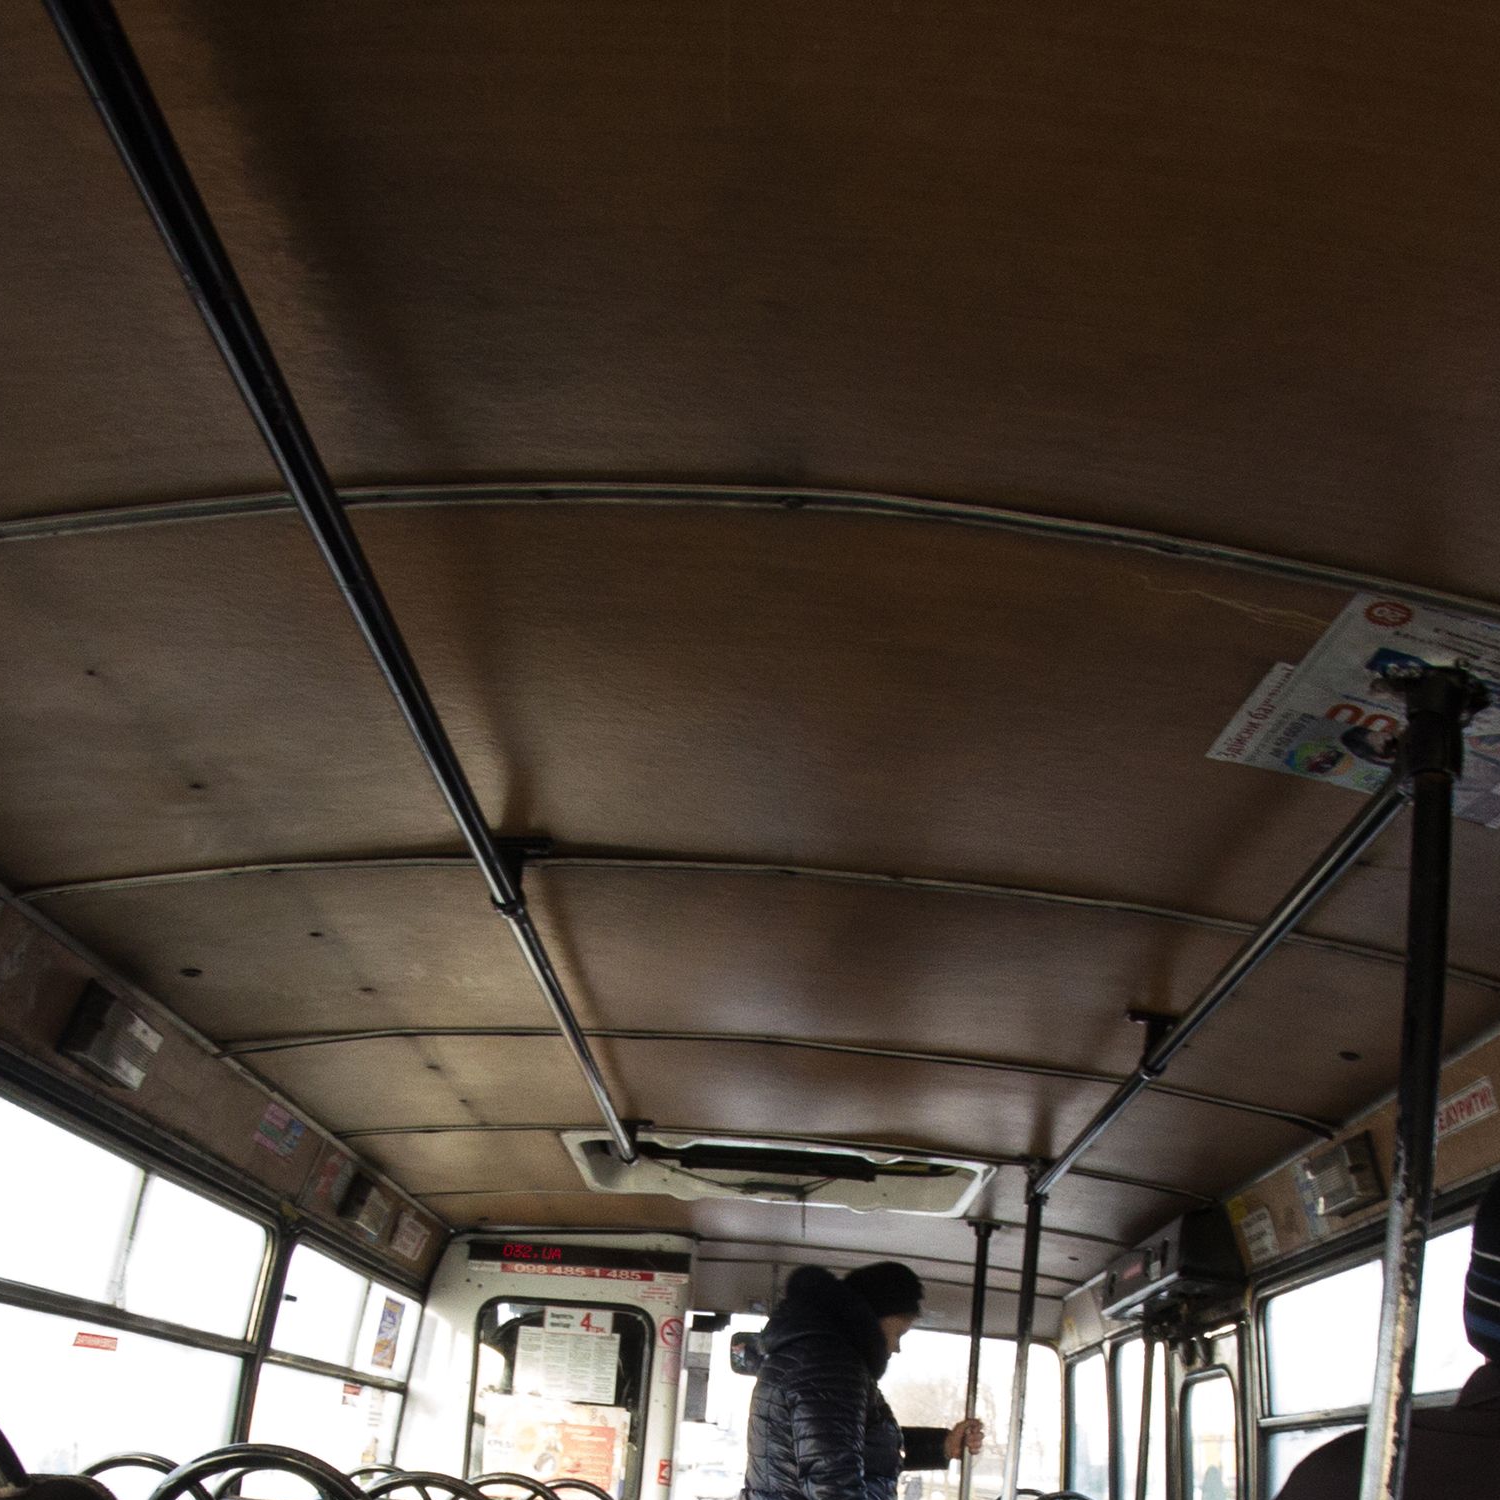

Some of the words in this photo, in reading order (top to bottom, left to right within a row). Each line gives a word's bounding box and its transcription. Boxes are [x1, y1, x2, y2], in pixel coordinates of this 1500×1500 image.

[513, 1263, 548, 1275] 098
[552, 1265, 586, 1277] 485
[606, 1270, 642, 1281] 485
[580, 1312, 593, 1332] 4
